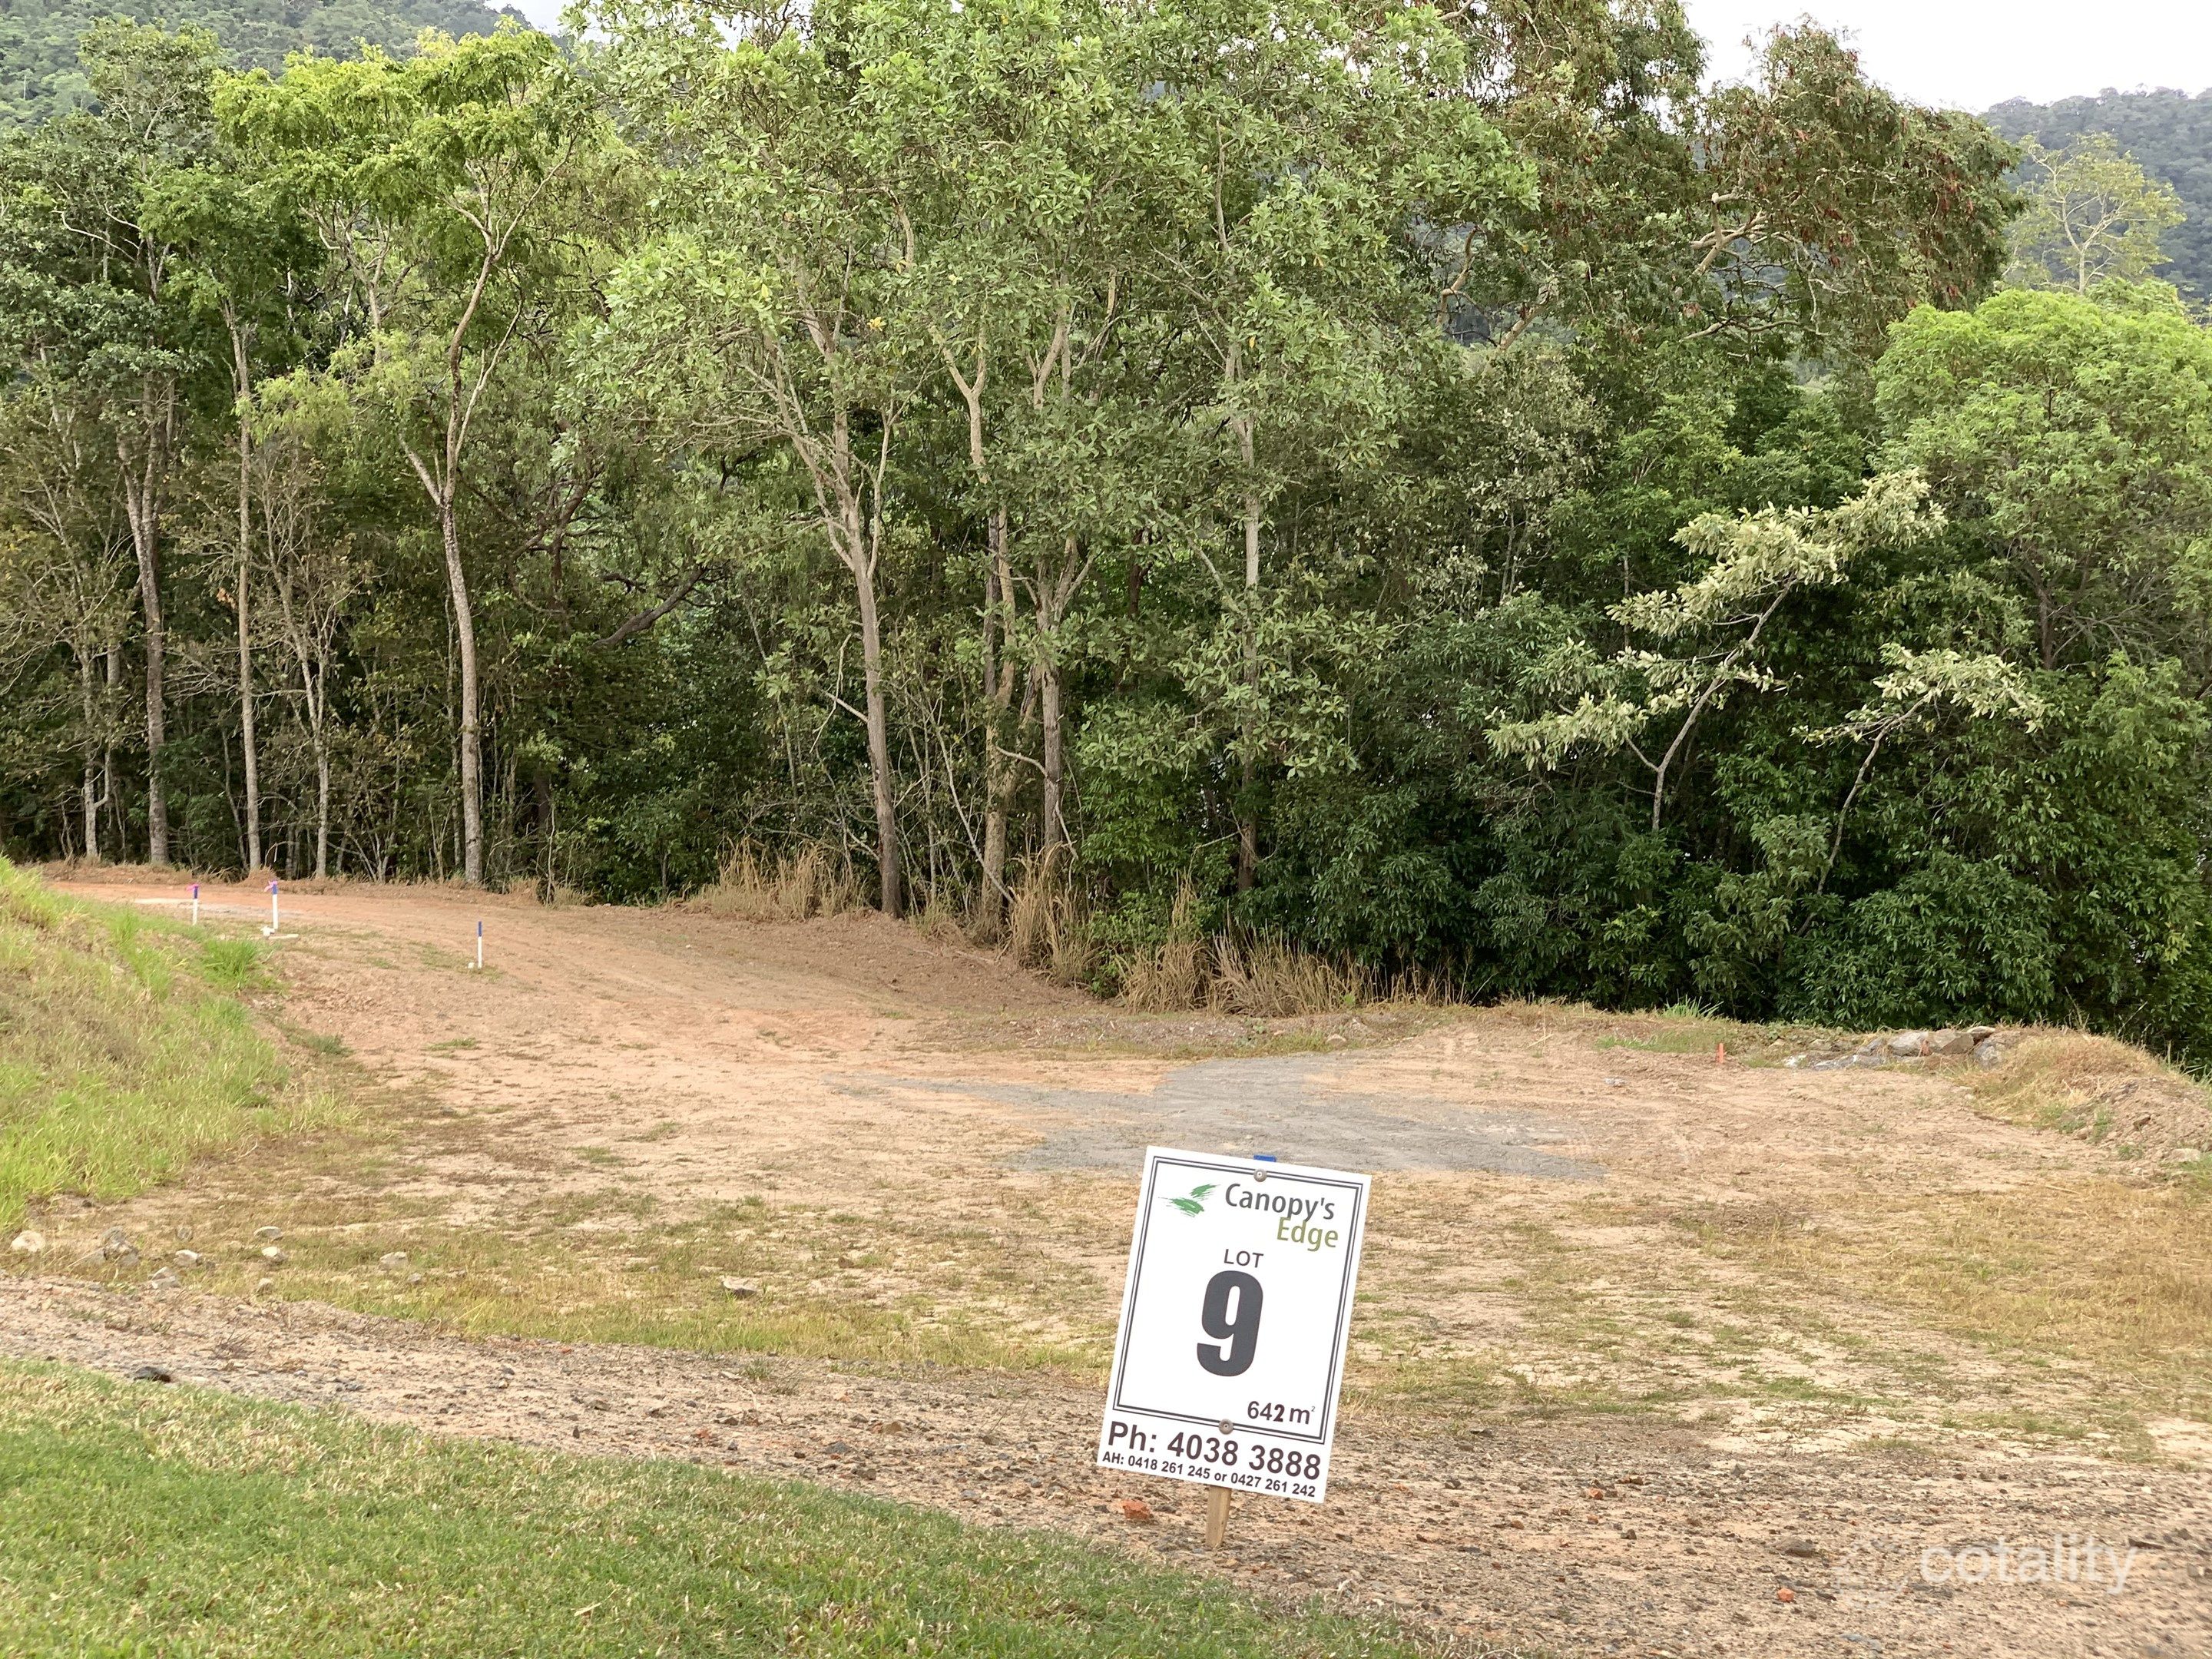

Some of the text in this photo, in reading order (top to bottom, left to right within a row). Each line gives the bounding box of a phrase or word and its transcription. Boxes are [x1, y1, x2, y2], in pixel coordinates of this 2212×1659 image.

[1225, 1183, 1335, 1222] Canopy's
[1277, 1217, 1339, 1252] Edge
[1224, 1249, 1264, 1268] LOT
[1196, 1270, 1263, 1377] 9
[1108, 1420, 1321, 1481] Ph: 4038 3888
[1101, 1451, 1316, 1498] AH: 0418 261 245 or 0427 261 242
